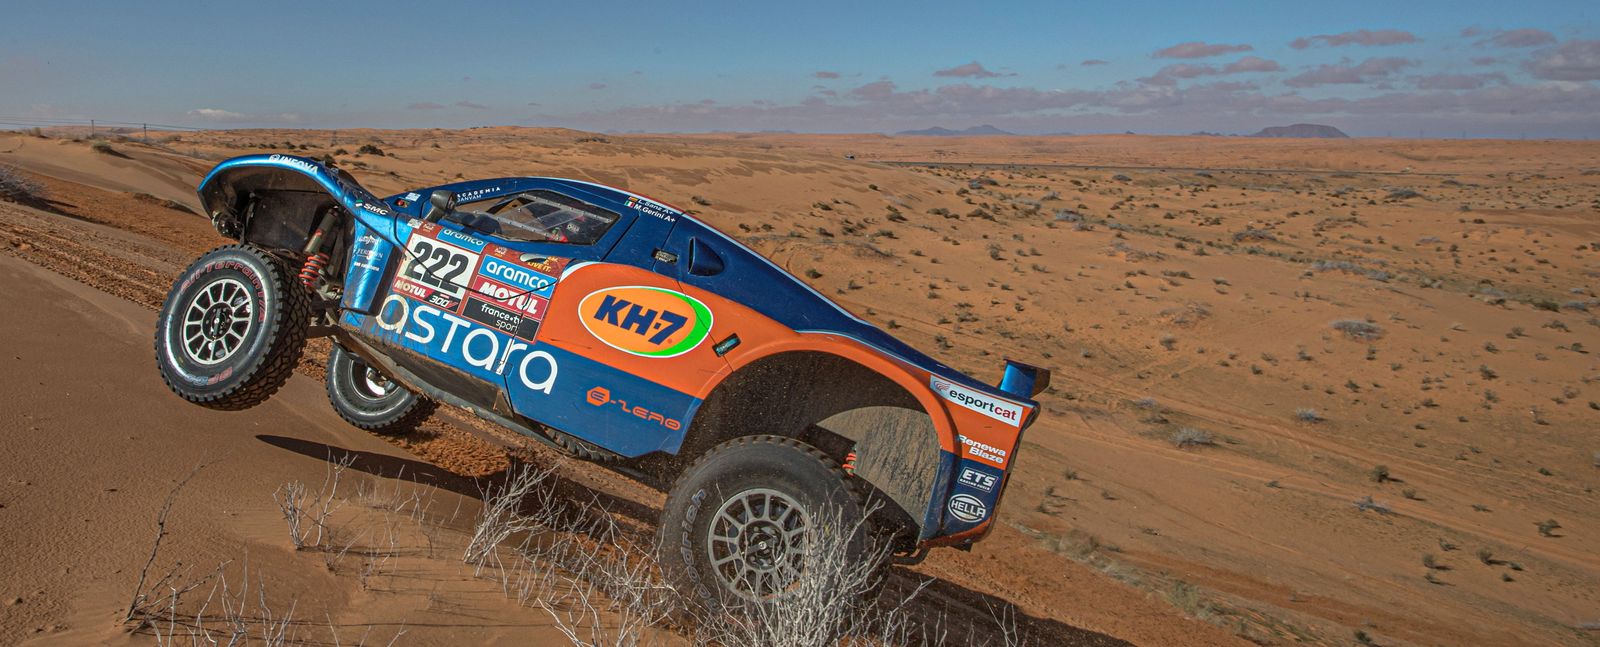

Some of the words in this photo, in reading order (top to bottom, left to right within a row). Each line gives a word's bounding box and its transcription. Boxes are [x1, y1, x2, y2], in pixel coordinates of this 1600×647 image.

[363, 202, 388, 215] SMC
[634, 204, 664, 219] M.Gerini
[443, 228, 484, 246] aramco
[404, 240, 470, 296] 222
[486, 260, 549, 291] aramco
[394, 280, 427, 298] MOTUL
[479, 283, 537, 314] MOTUL
[949, 389, 1017, 421] esportcat
[968, 447, 1004, 464] Blaze
[961, 469, 997, 486] ETS
[951, 498, 986, 518] HELLA
